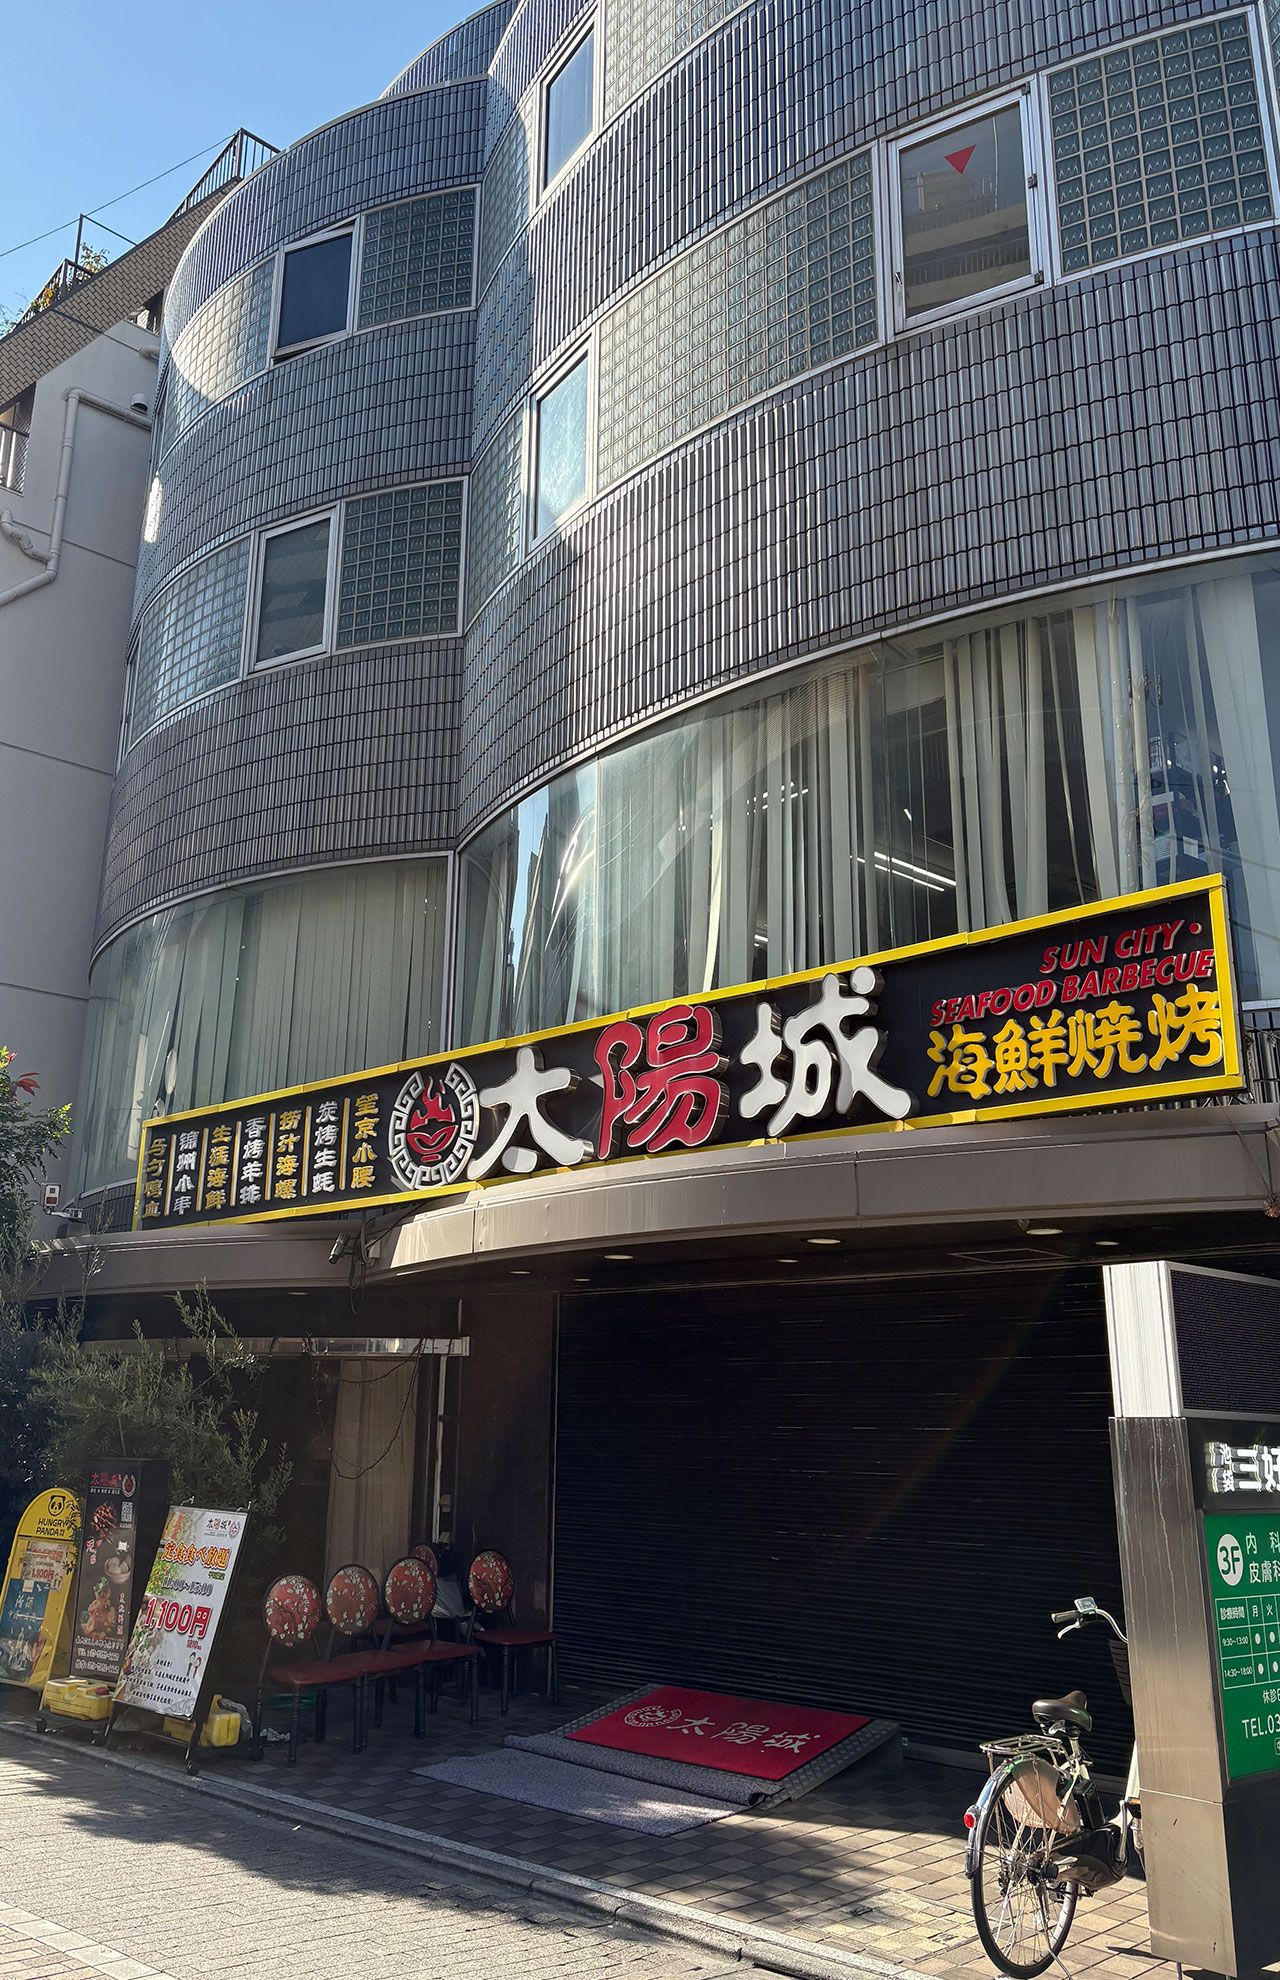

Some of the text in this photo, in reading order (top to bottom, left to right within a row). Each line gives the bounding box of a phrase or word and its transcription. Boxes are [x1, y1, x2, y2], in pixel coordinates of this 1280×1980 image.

[1039, 935, 1107, 974] SUN
[929, 949, 1214, 1027] SEAFOOD BARBECUE
[467, 965, 912, 1181] 太陽城
[239, 1116, 266, 1205] 香烤羊排
[38, 1517, 67, 1528] HUNGRY
[1219, 1545, 1240, 1575] 3F
[144, 1597, 213, 1639] 1,100円
[1220, 1606, 1245, 1620] 診療時間
[1252, 1605, 1258, 1618] 月
[1266, 1603, 1273, 1616] 火
